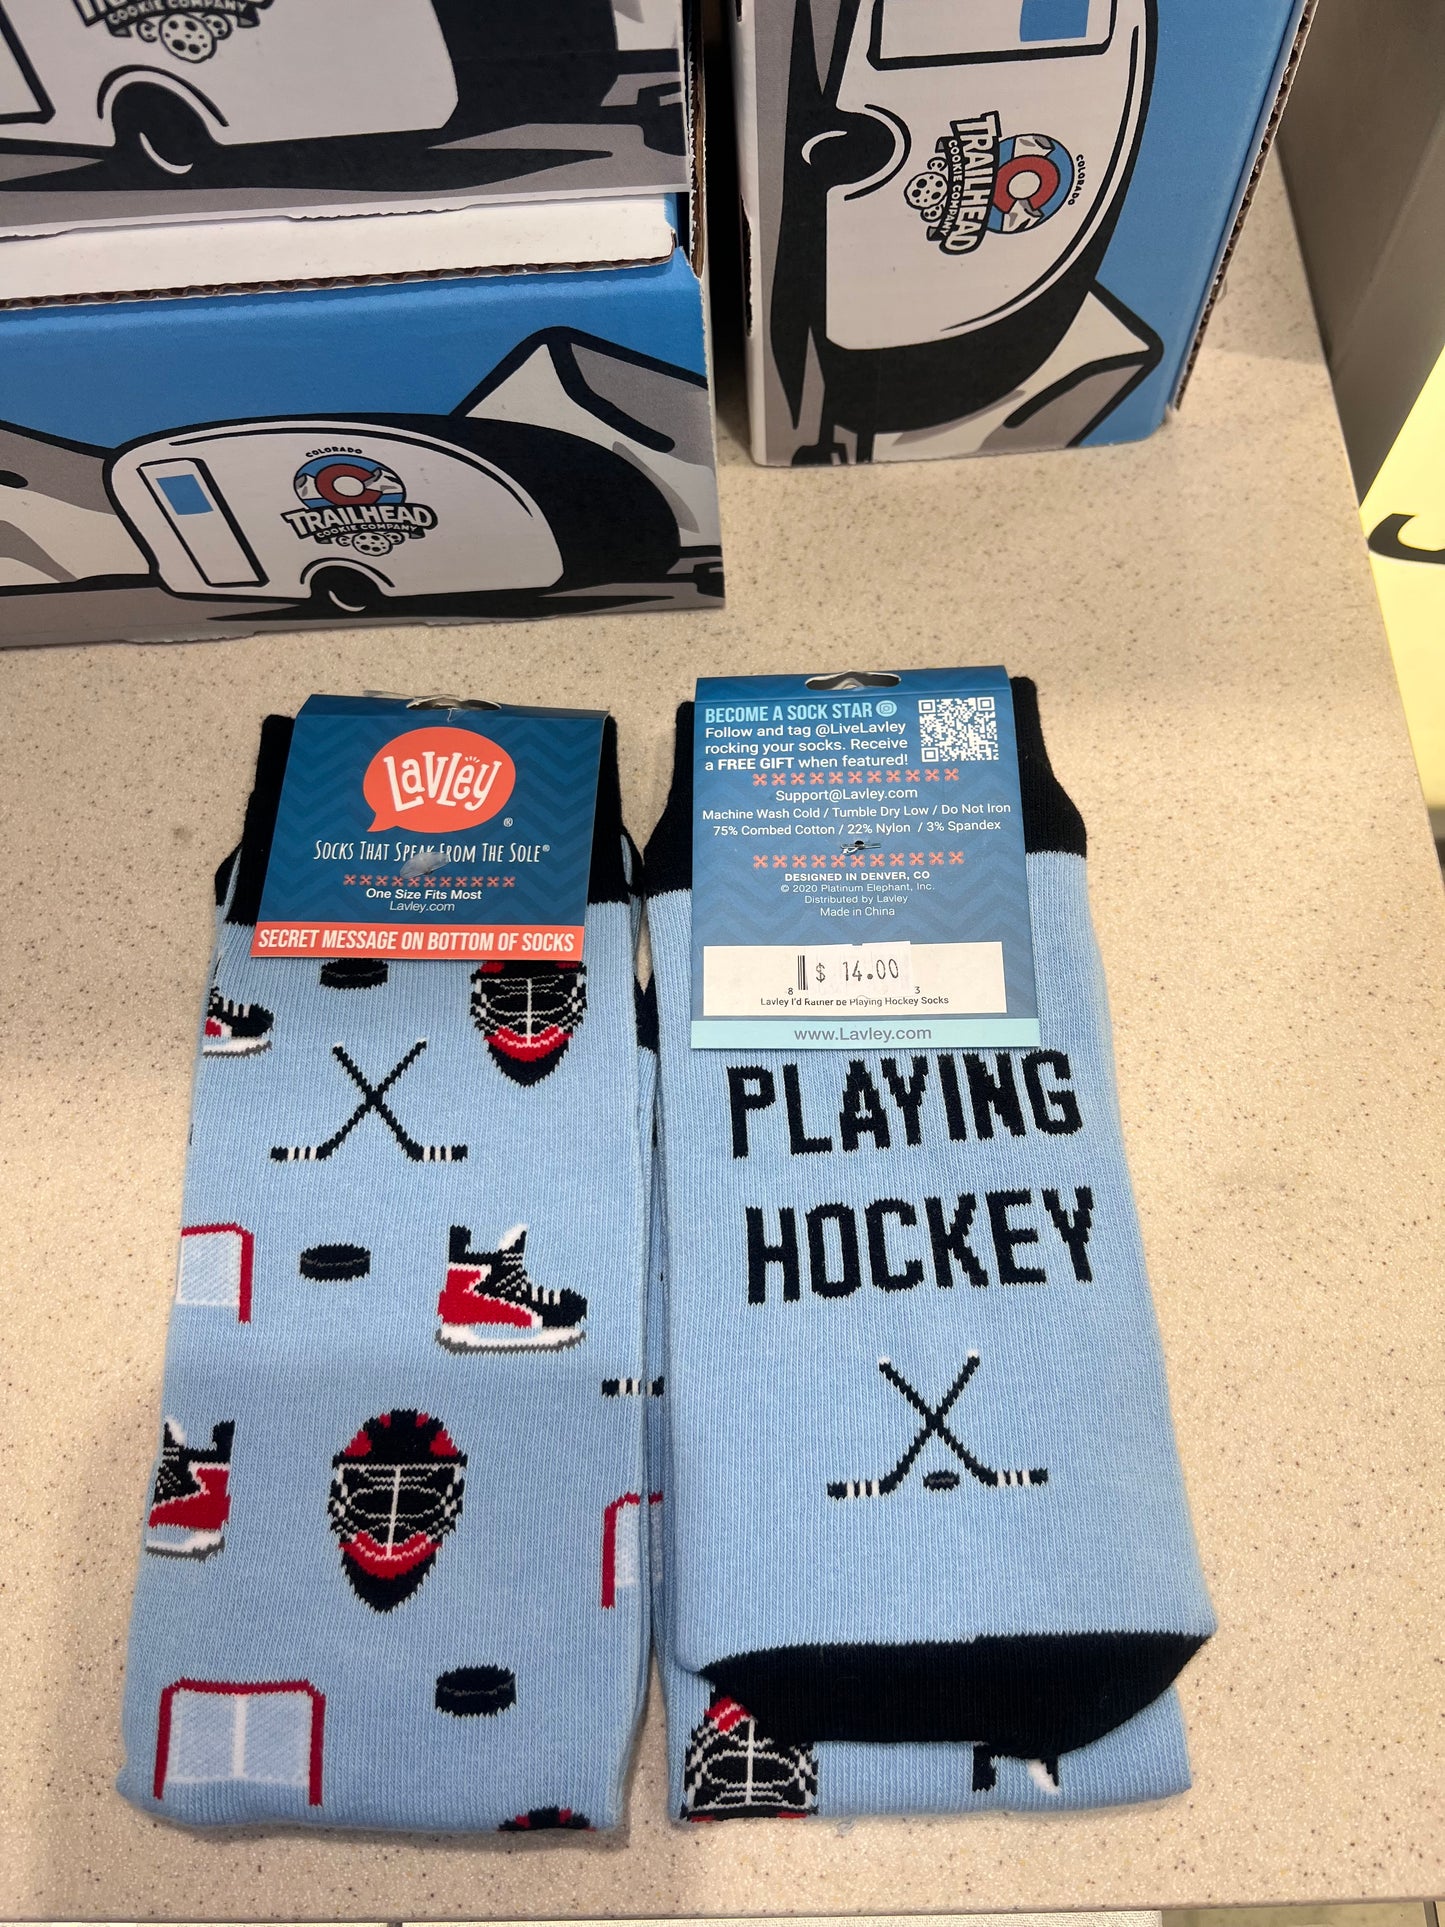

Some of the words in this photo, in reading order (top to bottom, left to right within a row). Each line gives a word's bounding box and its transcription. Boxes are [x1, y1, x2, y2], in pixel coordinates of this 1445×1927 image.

[107, 0, 165, 25] COOKIE
[948, 139, 963, 182] COOKIE
[945, 114, 998, 250] TRAILHEAD
[1068, 154, 1086, 206] COLORADO
[939, 185, 963, 236] COMPANY
[305, 446, 364, 458] COLORADO
[284, 505, 433, 537] TRAILHEAD
[316, 524, 357, 539] COOKIE
[360, 523, 418, 533] COMPANY
[705, 705, 769, 724] BECOME
[773, 706, 784, 722] A
[787, 703, 829, 721] SOCK
[832, 702, 873, 719] STAR
[705, 726, 752, 739] Follow
[757, 725, 784, 737] and
[787, 725, 811, 738] tag
[815, 721, 907, 738] @LiveLavley
[705, 742, 759, 755] rocking
[762, 743, 795, 754] your
[798, 739, 846, 752] socks.
[850, 737, 909, 750] Receive
[705, 761, 714, 771] a
[718, 758, 756, 770] FREE
[760, 757, 795, 769] GIFT
[798, 756, 838, 768] when
[842, 753, 909, 768] featured!
[775, 788, 918, 802] Support@Lavley.com
[702, 809, 754, 820] Machine
[756, 808, 790, 819] Wash
[793, 807, 821, 819] Cold
[823, 808, 829, 819] /
[832, 806, 877, 818] Tumble
[880, 805, 901, 818] Dry
[903, 805, 929, 816] Low
[932, 805, 938, 816] /
[941, 804, 958, 815] Do
[961, 803, 985, 814] Not
[987, 803, 1011, 814] Iron
[713, 825, 738, 836] 75%
[741, 824, 791, 836] Combed
[794, 823, 835, 835] Cotton
[838, 824, 844, 835] /
[847, 823, 873, 834] 22%
[876, 822, 911, 834] Nylon
[917, 822, 923, 833] /
[926, 821, 945, 832] 3%
[948, 820, 1001, 833] Spandex
[785, 873, 842, 882] DESIGNED
[845, 873, 857, 881] IN
[861, 872, 910, 881] DENVER,
[913, 871, 930, 879] CO
[366, 888, 392, 900] One
[395, 889, 422, 900] Size
[425, 889, 448, 900] Fits
[450, 889, 482, 900] Most
[793, 884, 818, 893] 2020
[821, 883, 864, 893] Platinum
[917, 882, 935, 891] Inc.
[390, 901, 455, 914] Lavley.com
[804, 895, 858, 904] Distributed
[861, 894, 873, 904] by
[877, 894, 908, 904] Lavley
[820, 907, 850, 917] Made
[853, 907, 862, 916] in
[865, 906, 895, 916] China
[258, 928, 320, 949] SECRET
[321, 930, 399, 950] MESSAGE
[401, 931, 425, 951] ON
[427, 931, 493, 951] BOTTOM
[497, 932, 518, 951] OF
[522, 932, 575, 953] SOCKS
[815, 962, 826, 983] $
[843, 958, 899, 982] 14.00
[787, 987, 794, 996] 8
[914, 986, 921, 995] 3
[760, 998, 788, 1007] Lavley
[791, 997, 802, 1006] I'd
[850, 998, 883, 1008] Playing
[884, 997, 919, 1006] Hockey
[921, 996, 949, 1004] Socks
[794, 1027, 932, 1043] www.Lavley.com
[726, 1049, 1084, 1160] PLAYING
[745, 1186, 1094, 1306] HOCKEY
